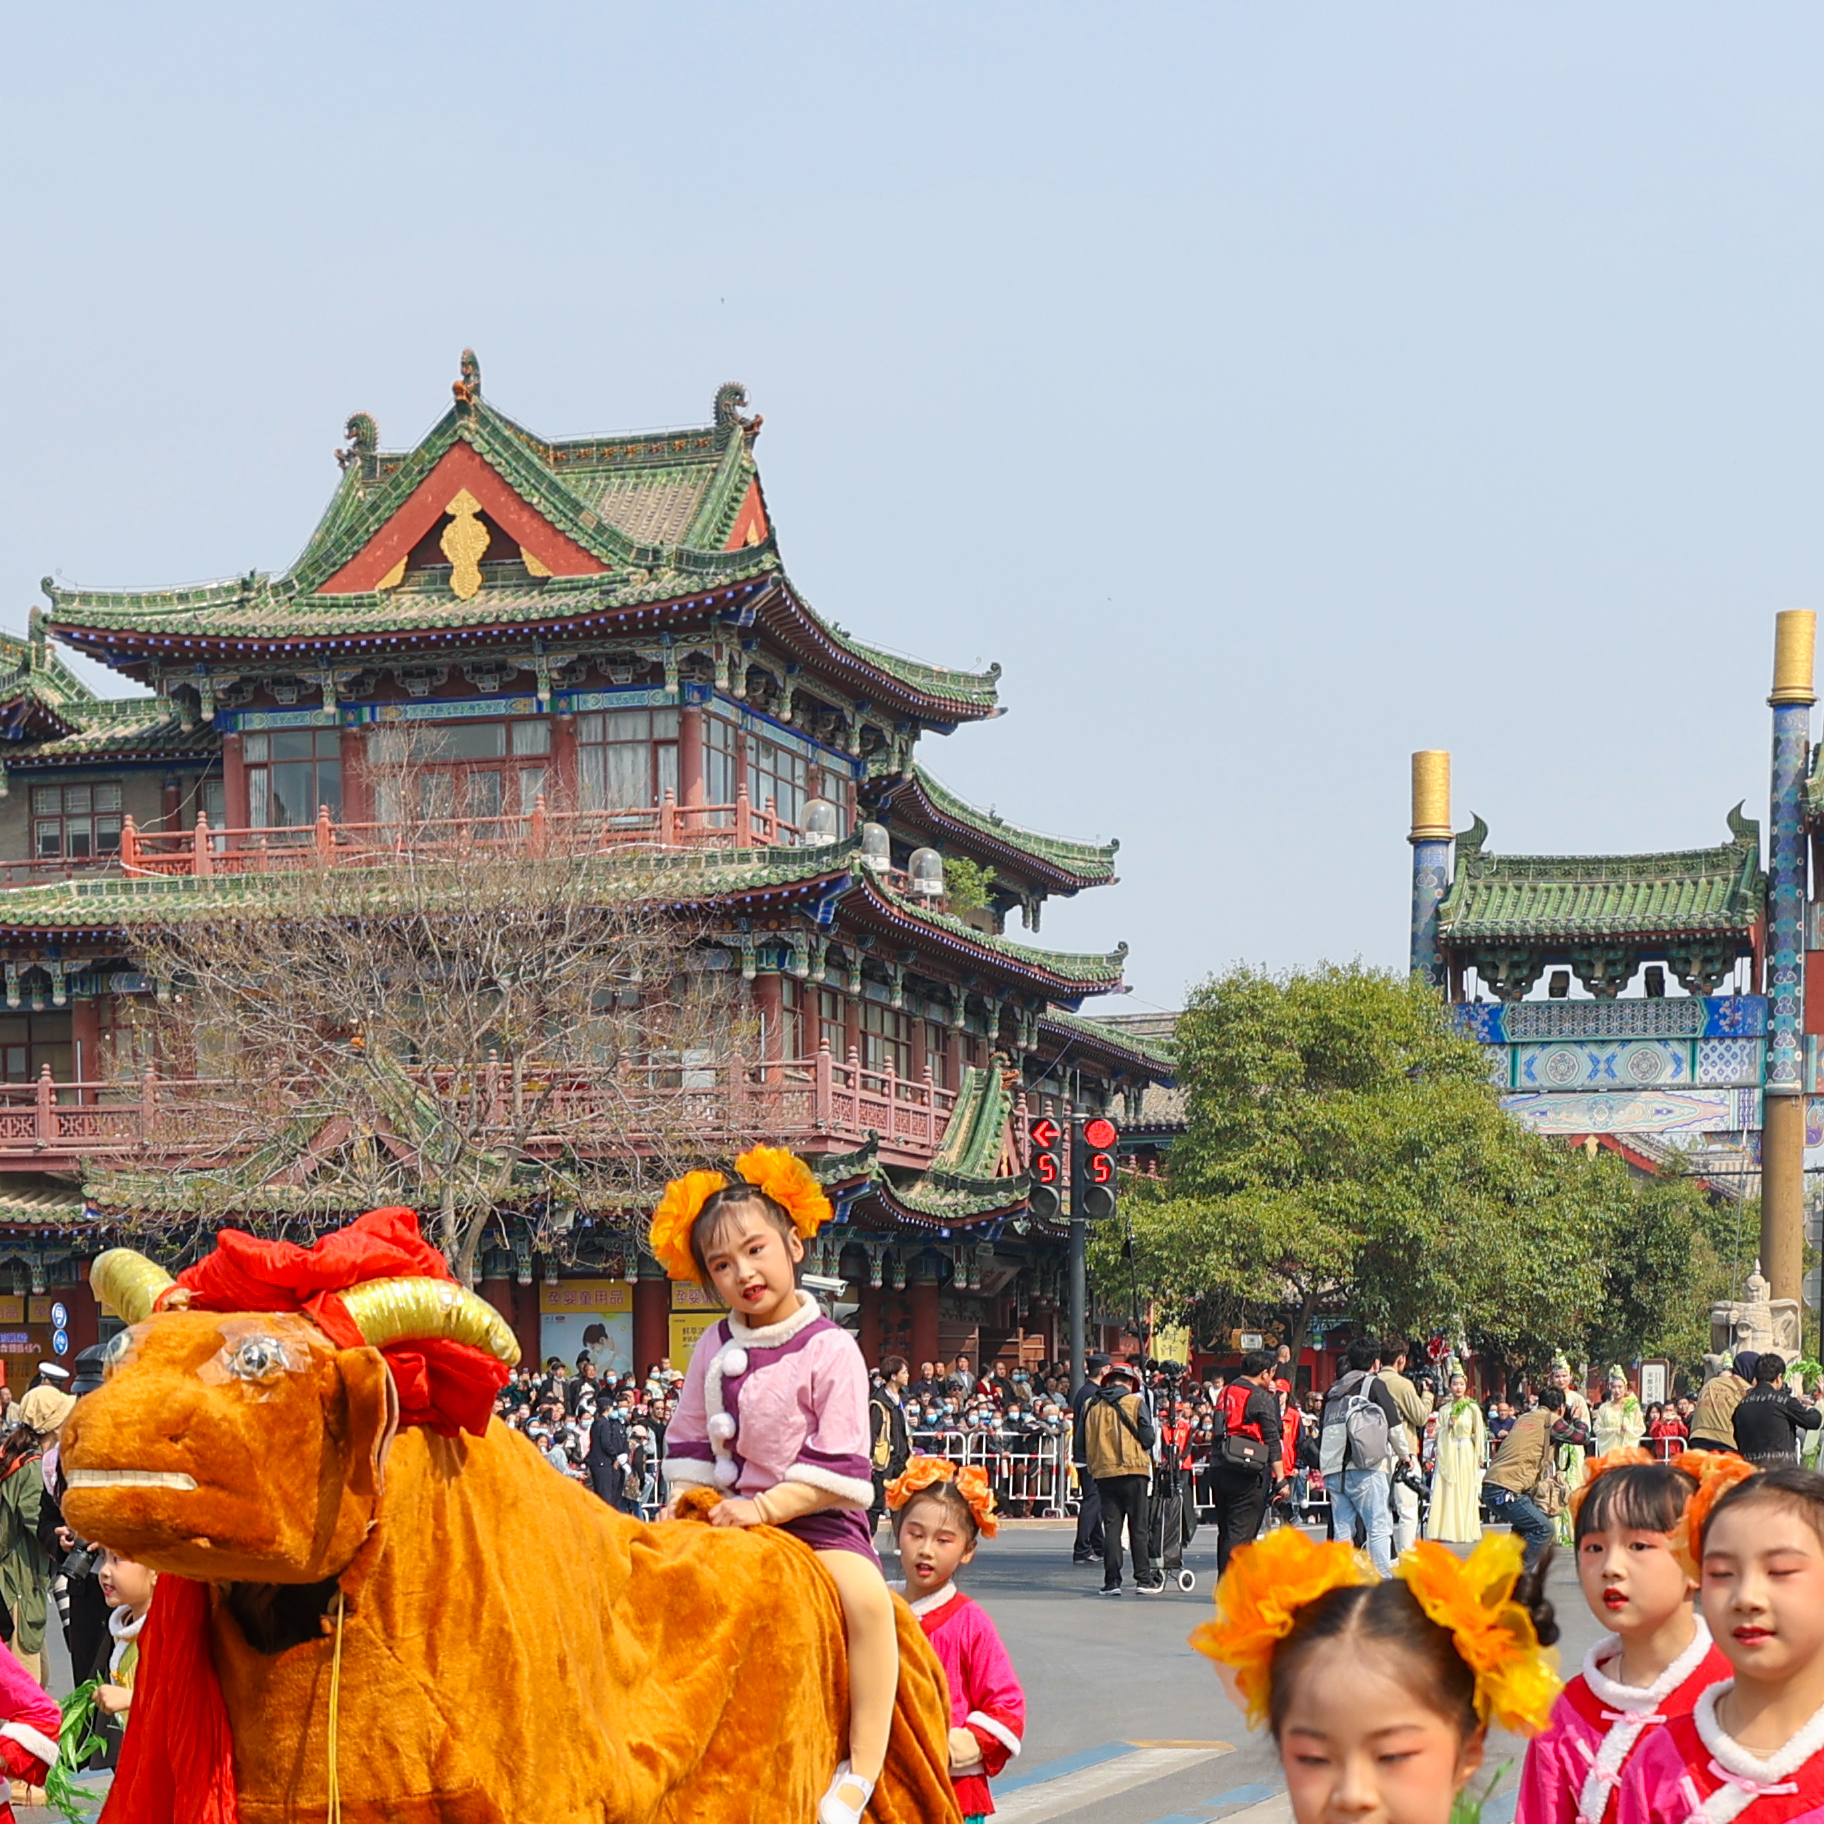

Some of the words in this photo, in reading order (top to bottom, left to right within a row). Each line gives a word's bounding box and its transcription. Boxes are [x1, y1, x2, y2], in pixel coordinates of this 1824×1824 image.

[1038, 1153, 1057, 1183] 5
[1092, 1153, 1111, 1183] 5
[547, 1290, 624, 1306] 孕婴童用品
